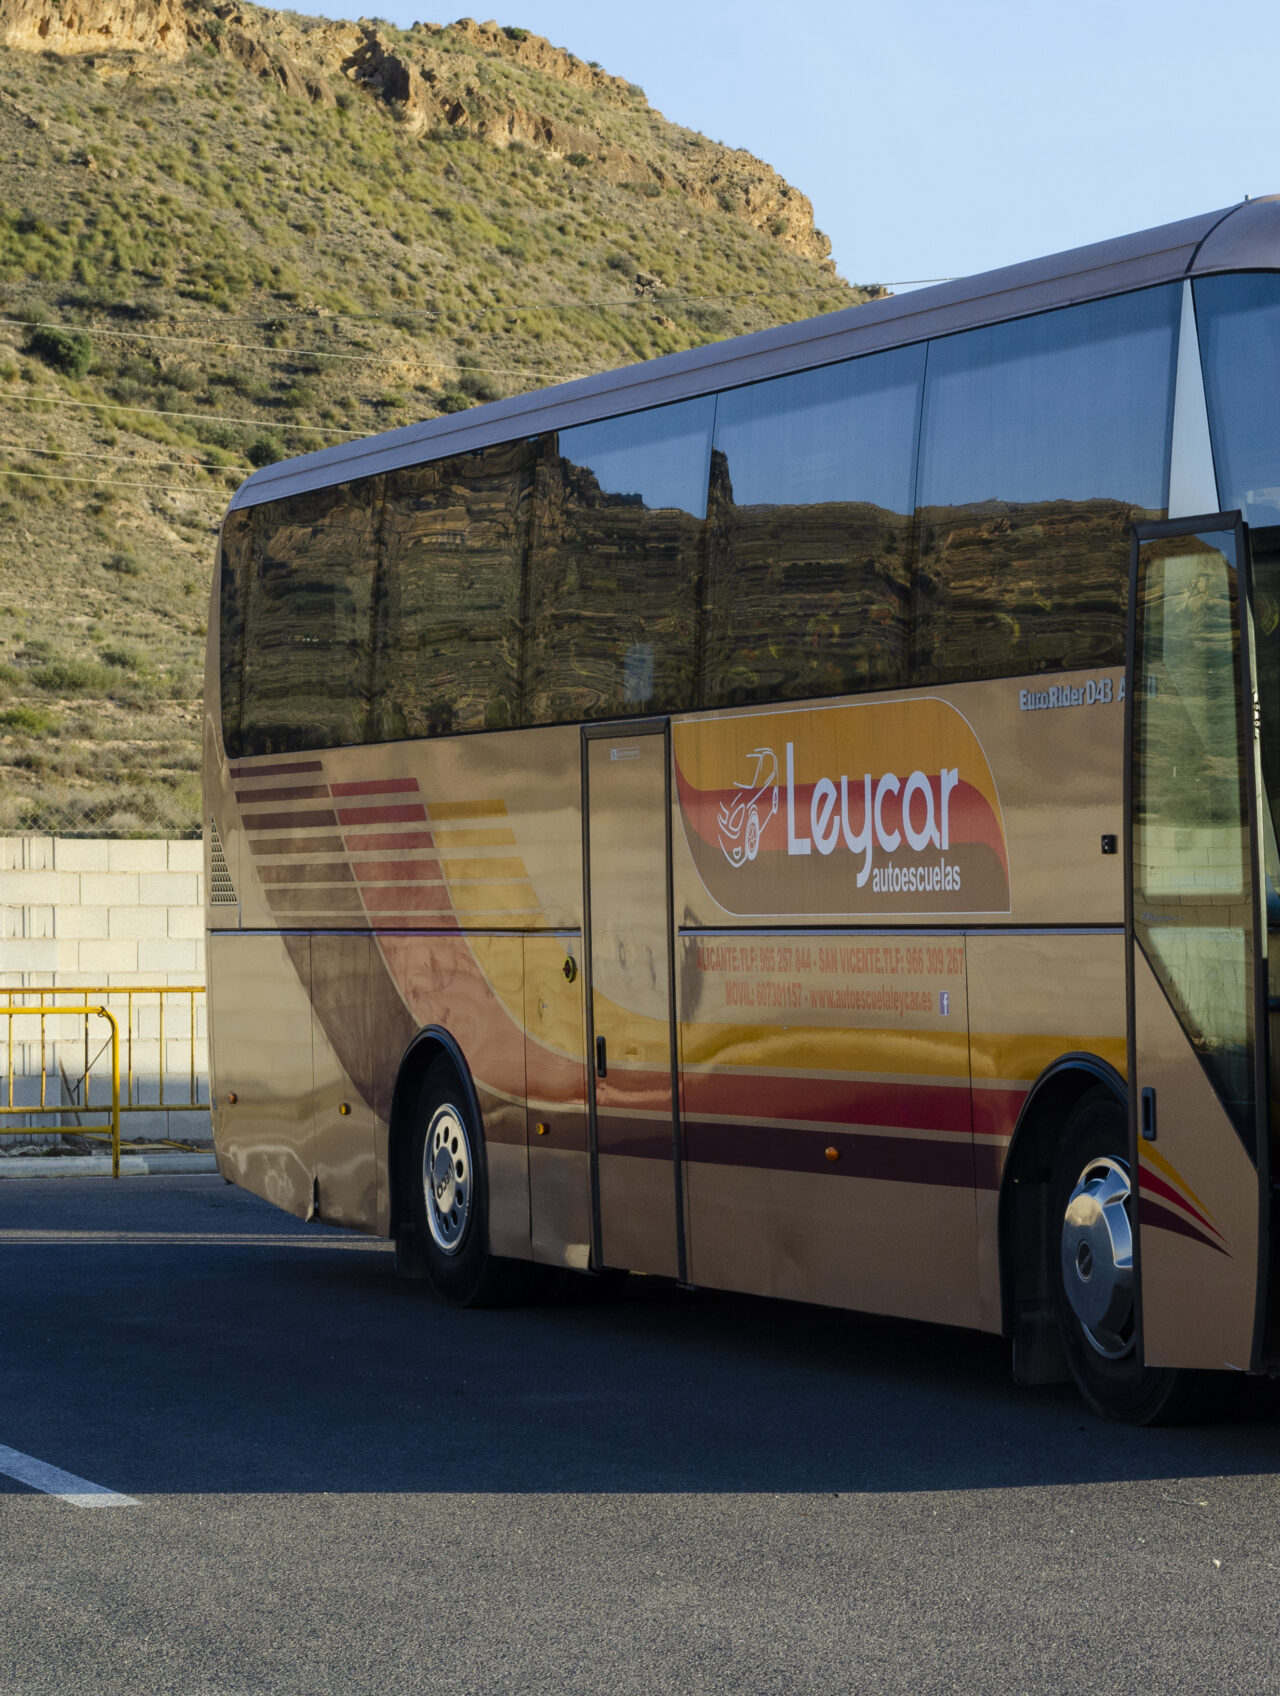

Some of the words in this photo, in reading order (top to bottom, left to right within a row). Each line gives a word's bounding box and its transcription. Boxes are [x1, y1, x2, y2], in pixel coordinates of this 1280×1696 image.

[1019, 684, 1086, 711] EuroRider
[1086, 678, 1114, 704] D43
[786, 741, 959, 889] Leycar
[872, 857, 961, 893] autoescuelas
[795, 946, 812, 973] 844
[818, 946, 838, 974] SAN
[906, 947, 924, 975] 966
[926, 947, 944, 975] 309
[946, 947, 964, 975] 267
